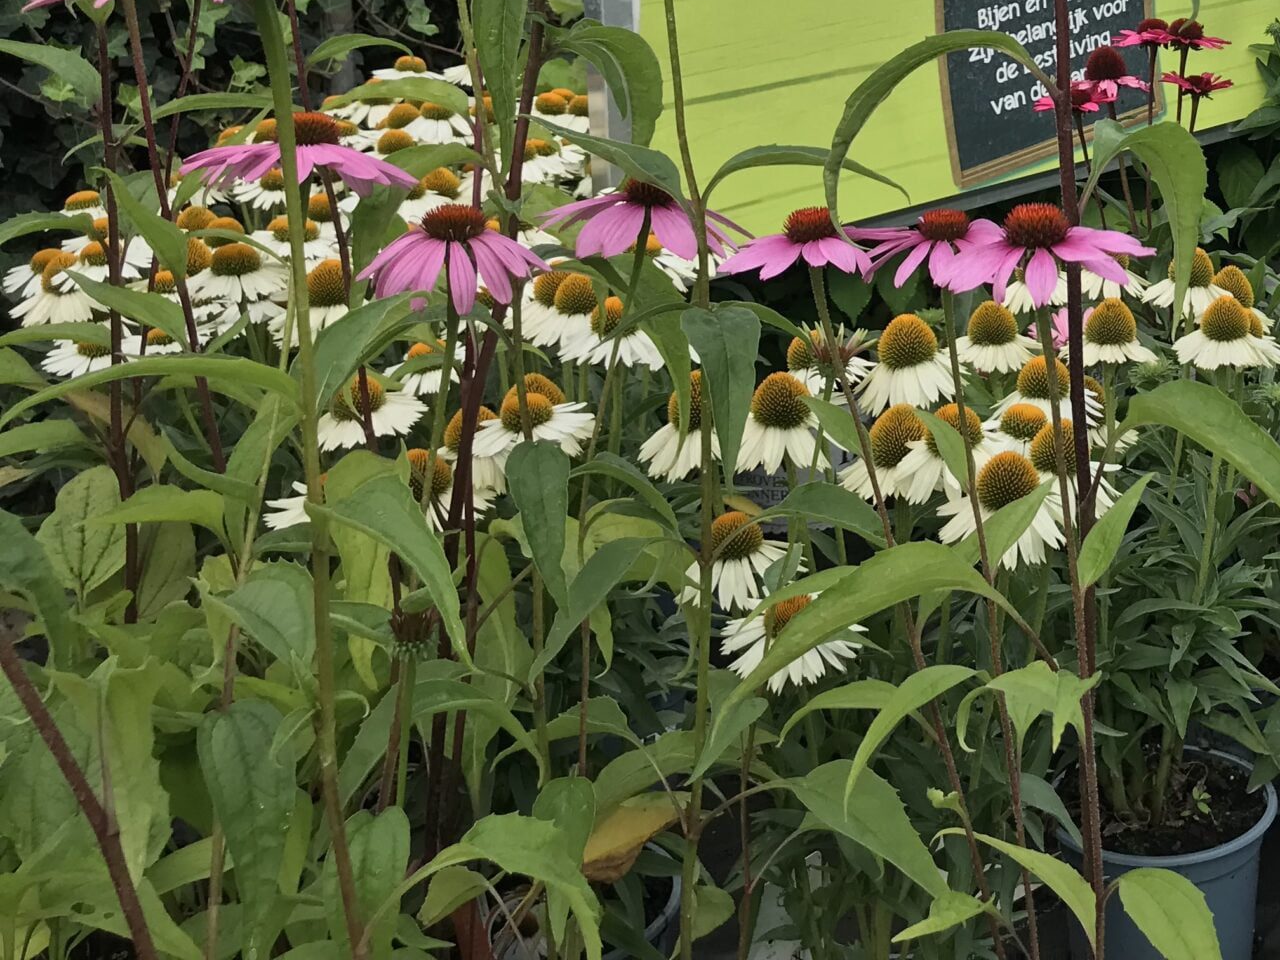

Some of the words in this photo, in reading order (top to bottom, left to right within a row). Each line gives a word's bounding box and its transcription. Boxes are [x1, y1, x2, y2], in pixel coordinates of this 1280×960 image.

[977, 2, 1020, 30] Bijen
[996, 61, 1019, 83] de
[990, 90, 1026, 115] van
